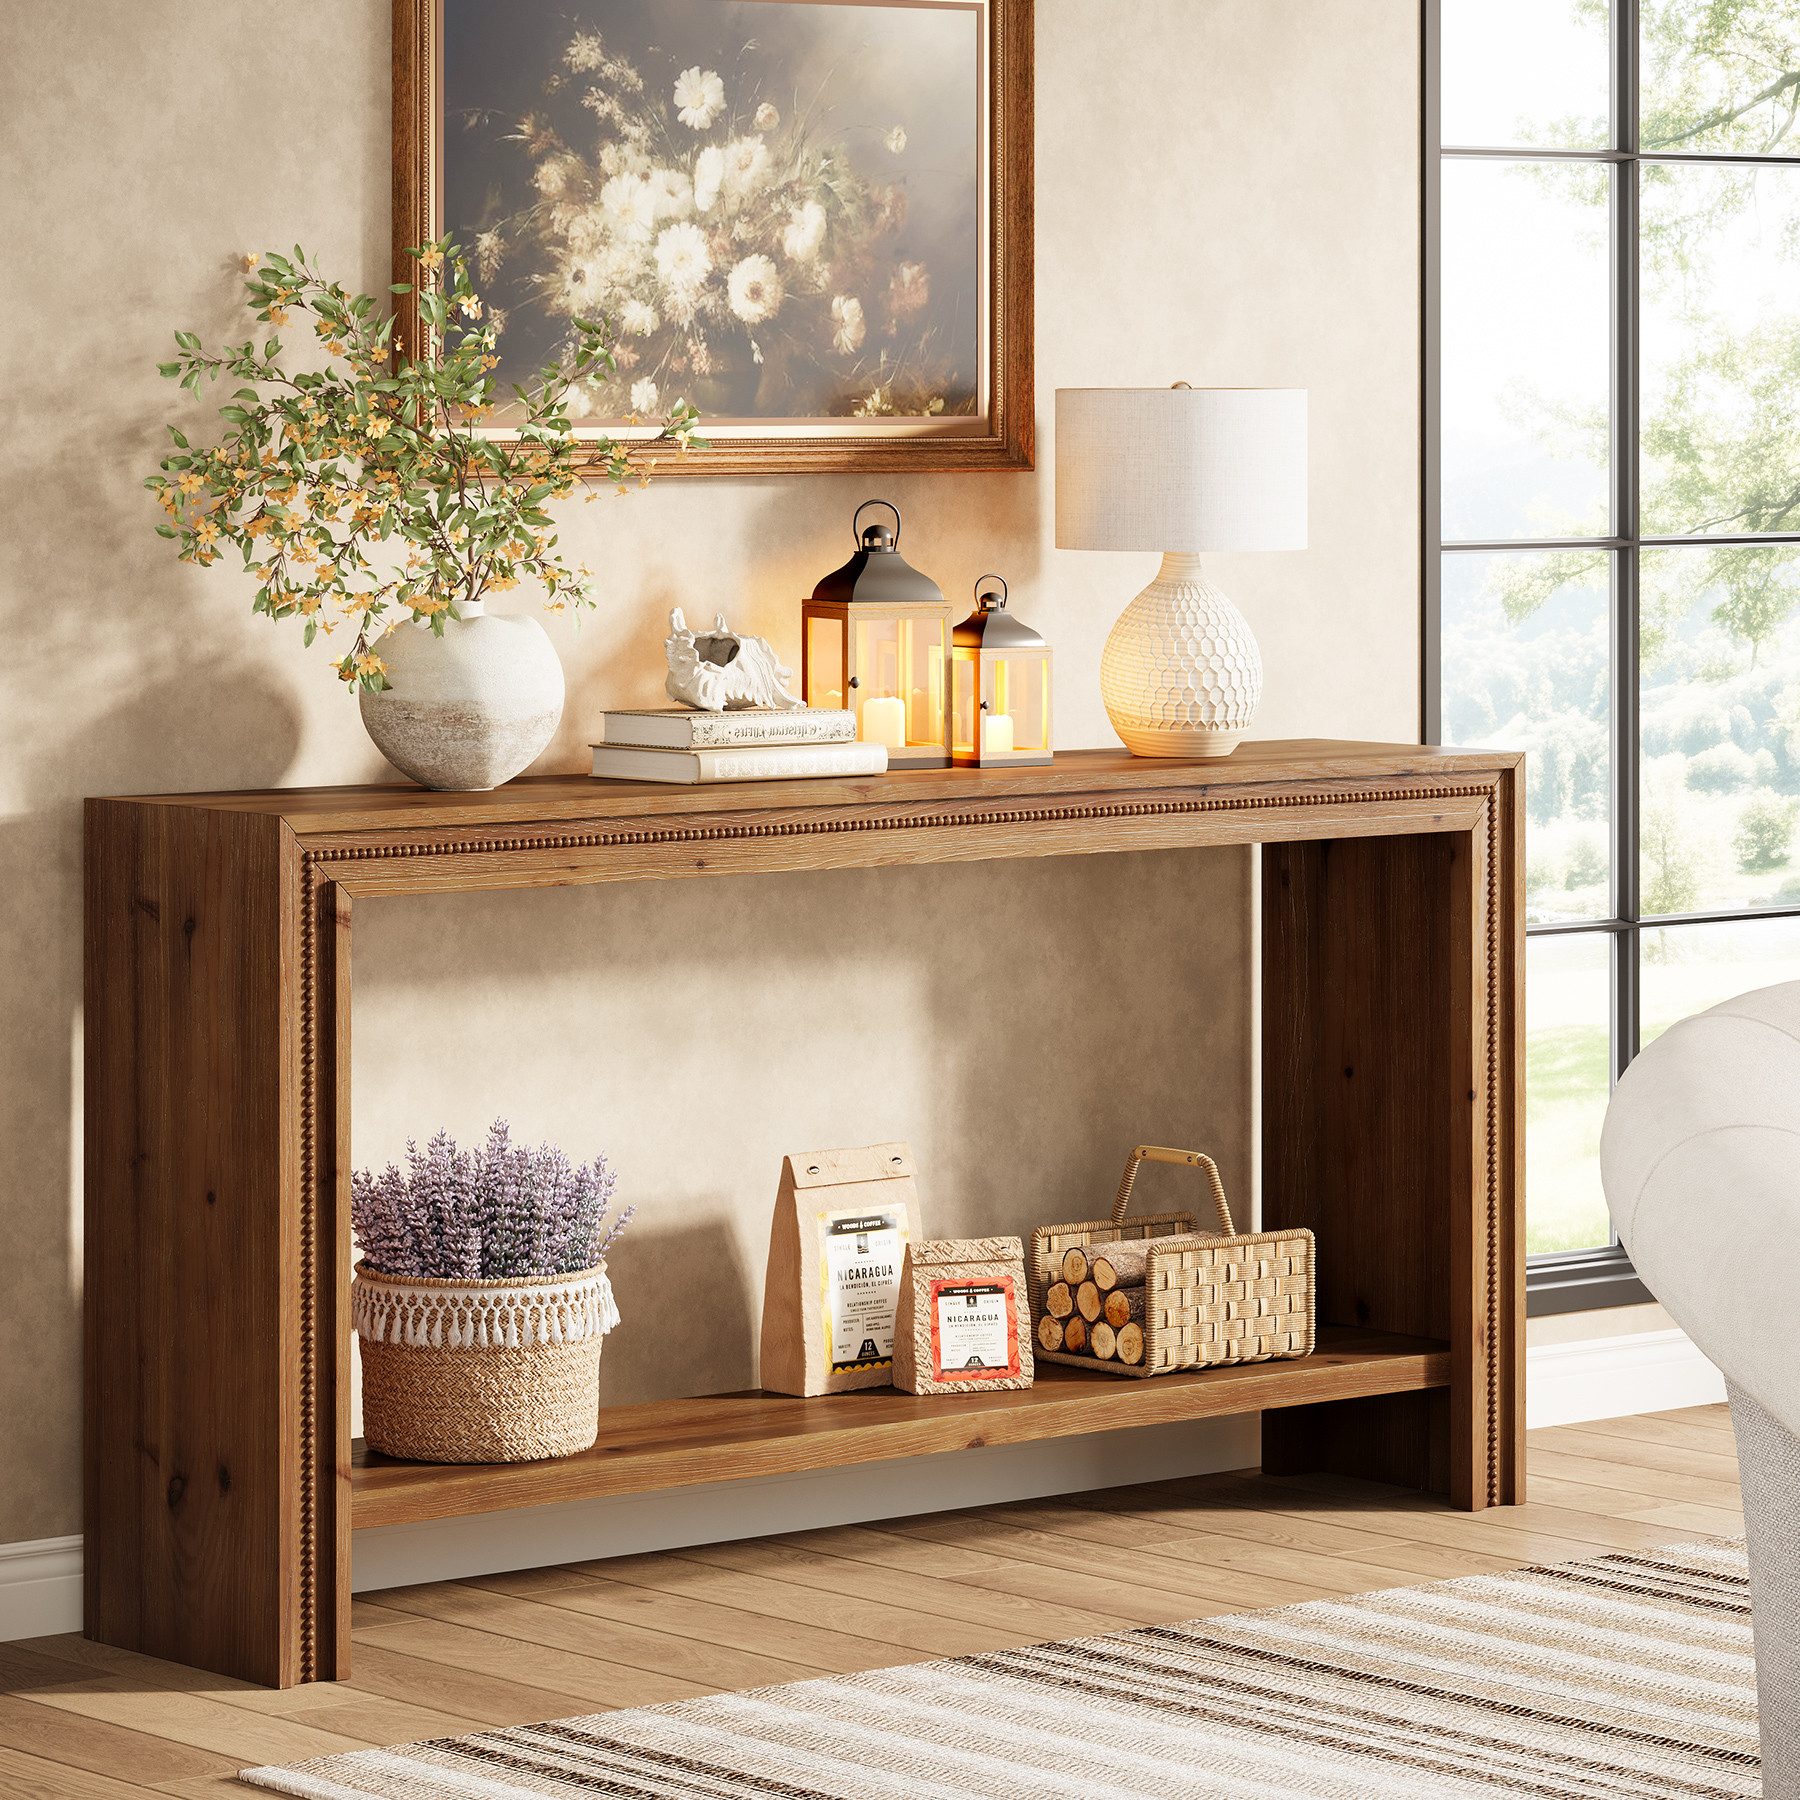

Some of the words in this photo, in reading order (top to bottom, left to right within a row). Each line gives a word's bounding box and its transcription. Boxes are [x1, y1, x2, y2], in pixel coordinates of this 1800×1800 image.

[863, 1219, 881, 1228] COFFEE
[837, 1264, 894, 1281] NICARAGUA
[947, 1314, 999, 1322] NICARAGUA
[864, 1341, 873, 1351] 12
